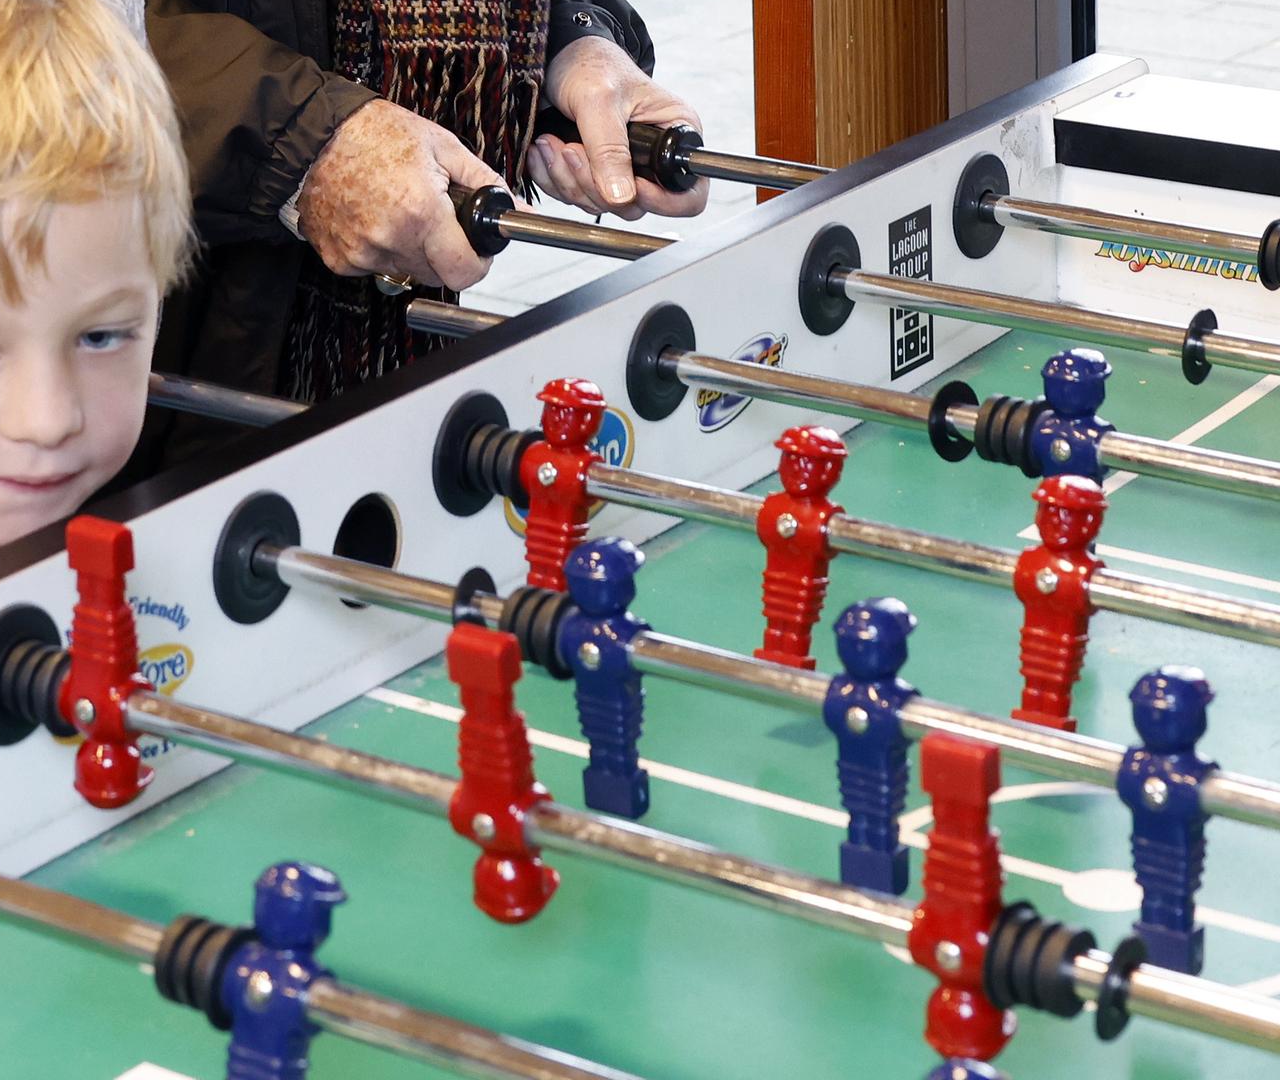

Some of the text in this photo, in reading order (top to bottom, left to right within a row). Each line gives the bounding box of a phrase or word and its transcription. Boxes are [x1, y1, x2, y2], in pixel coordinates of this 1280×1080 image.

[904, 217, 918, 234] THE
[892, 227, 928, 262] LAGOON
[892, 251, 929, 278] GROUP
